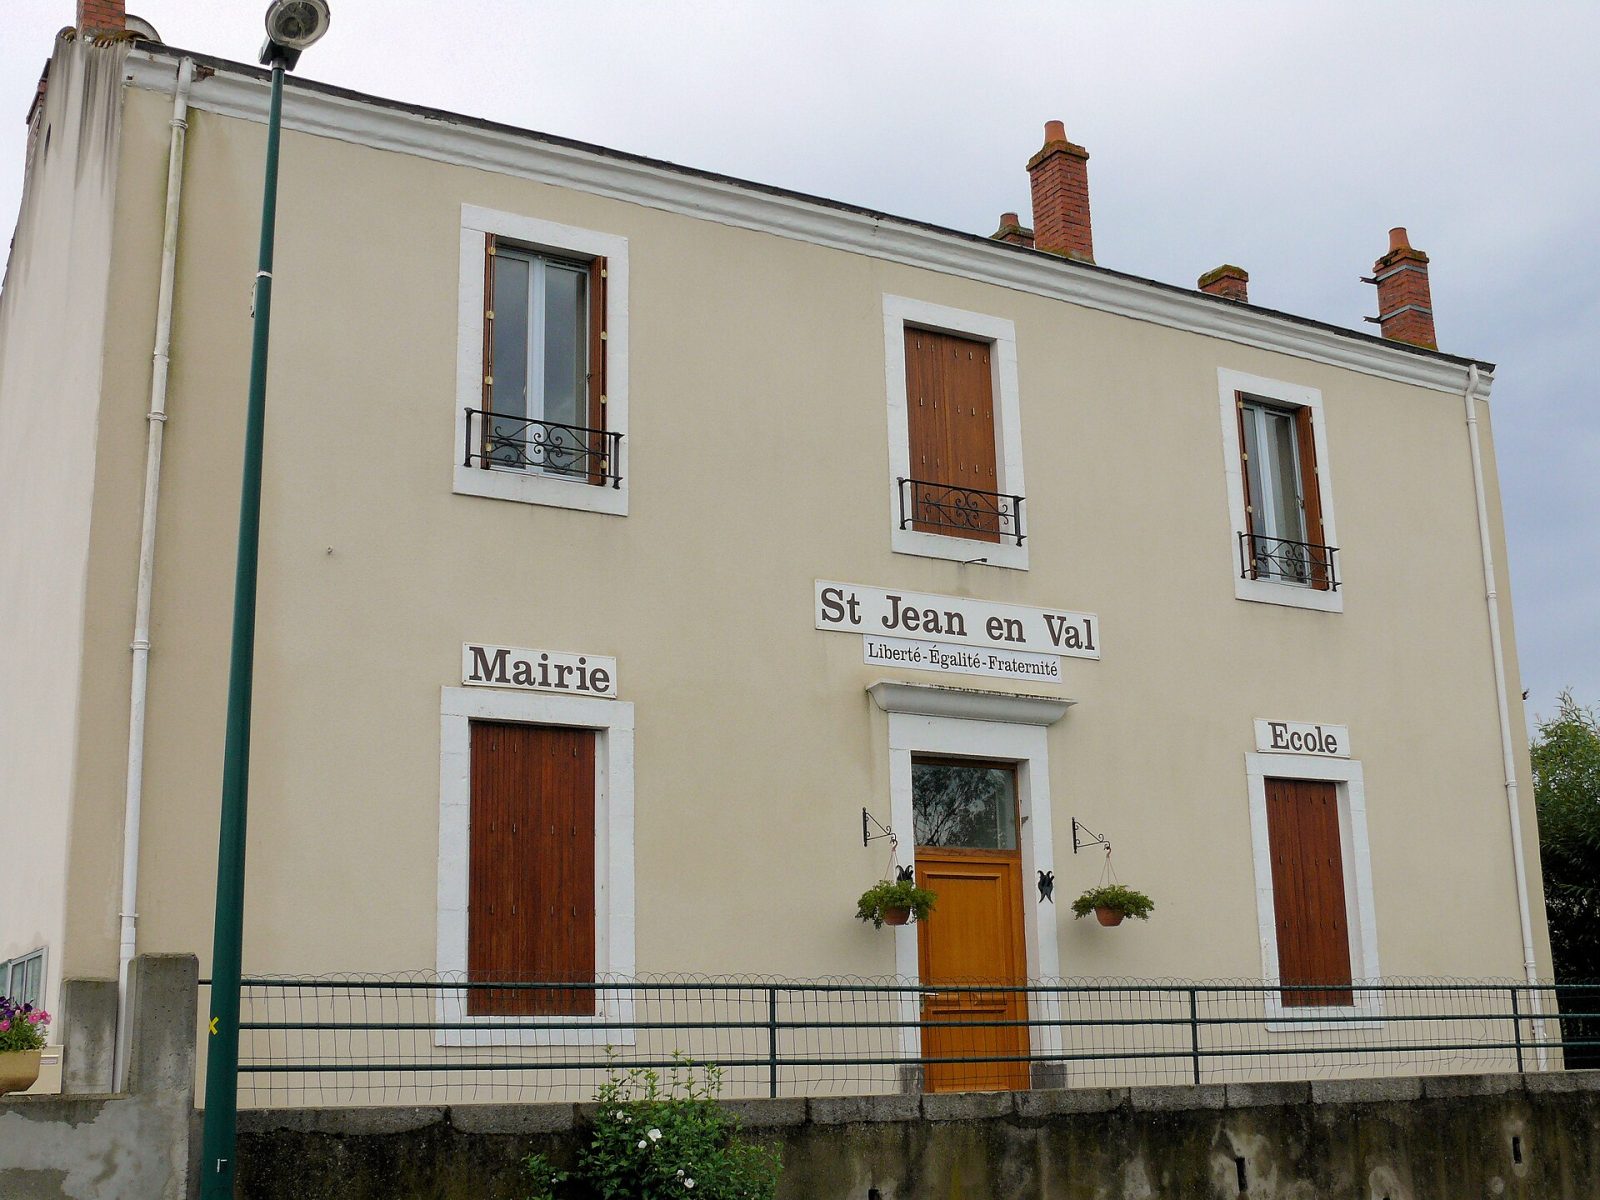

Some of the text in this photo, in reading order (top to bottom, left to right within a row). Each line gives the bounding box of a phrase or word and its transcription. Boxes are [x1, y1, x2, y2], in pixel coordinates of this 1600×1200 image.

[821, 588, 1095, 651] St Jean en Val
[469, 646, 610, 693] Mairie
[1268, 722, 1337, 754] Ecole
